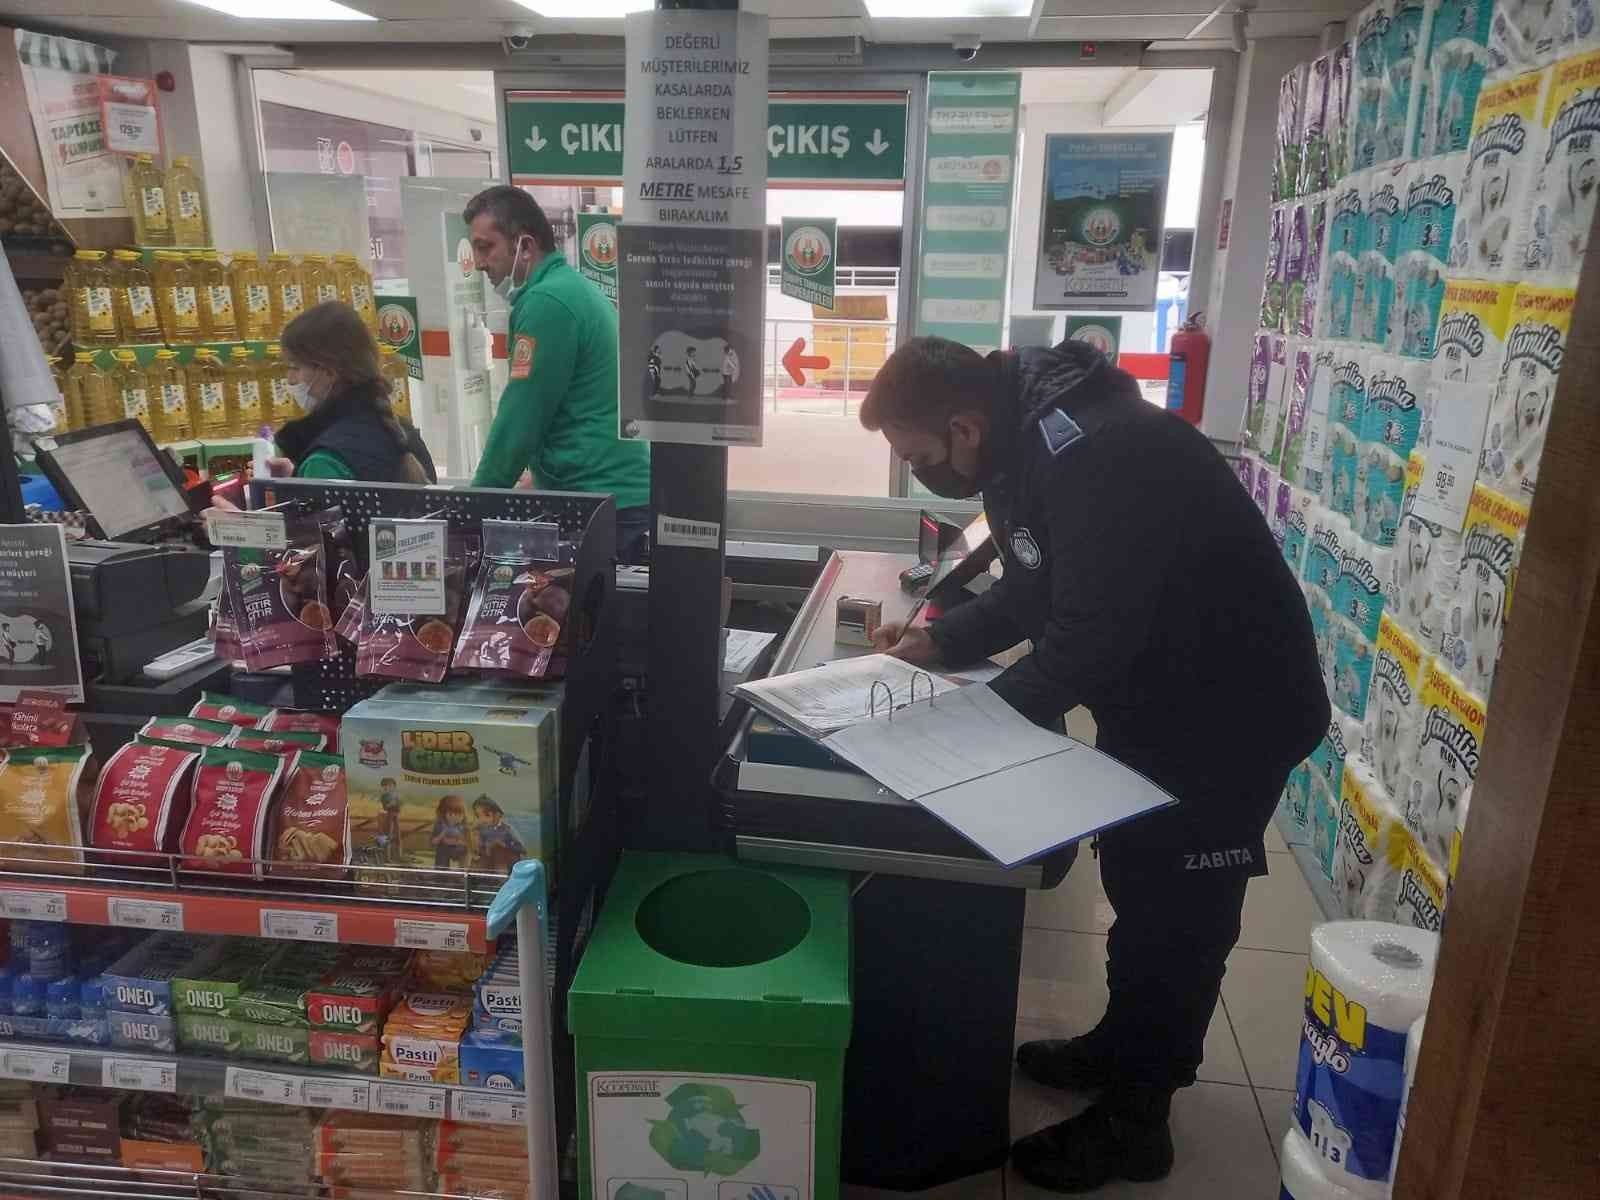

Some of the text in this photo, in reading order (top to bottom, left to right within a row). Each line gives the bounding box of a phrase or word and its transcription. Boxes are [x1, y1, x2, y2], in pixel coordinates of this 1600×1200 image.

[665, 33, 721, 49] DEĞERLİ
[655, 84, 732, 98] KASALARDA
[656, 107, 730, 120] BEKLERKEN
[561, 123, 621, 155] ÇIKI
[668, 130, 718, 144] LÜTFEN
[768, 125, 850, 158] ÇIKIŞ
[1567, 134, 1593, 152] PLUS
[646, 156, 713, 169] ARALARDA
[640, 182, 749, 200] METRE MESAFE
[659, 208, 729, 222] BIRAKALIM
[1420, 703, 1480, 780] familia
[1440, 746, 1458, 769] PLUS
[1183, 848, 1254, 870] ZABITA
[117, 986, 154, 1007] ONEO
[186, 990, 225, 1009] ONEO
[486, 994, 521, 1008] Pasti
[322, 1004, 362, 1024] ONEO
[122, 1021, 159, 1041] ONEO
[192, 1023, 230, 1042] ONEO
[256, 1034, 294, 1054] ONEO
[323, 1040, 362, 1062] ONEO
[396, 1046, 437, 1062] Pastil
